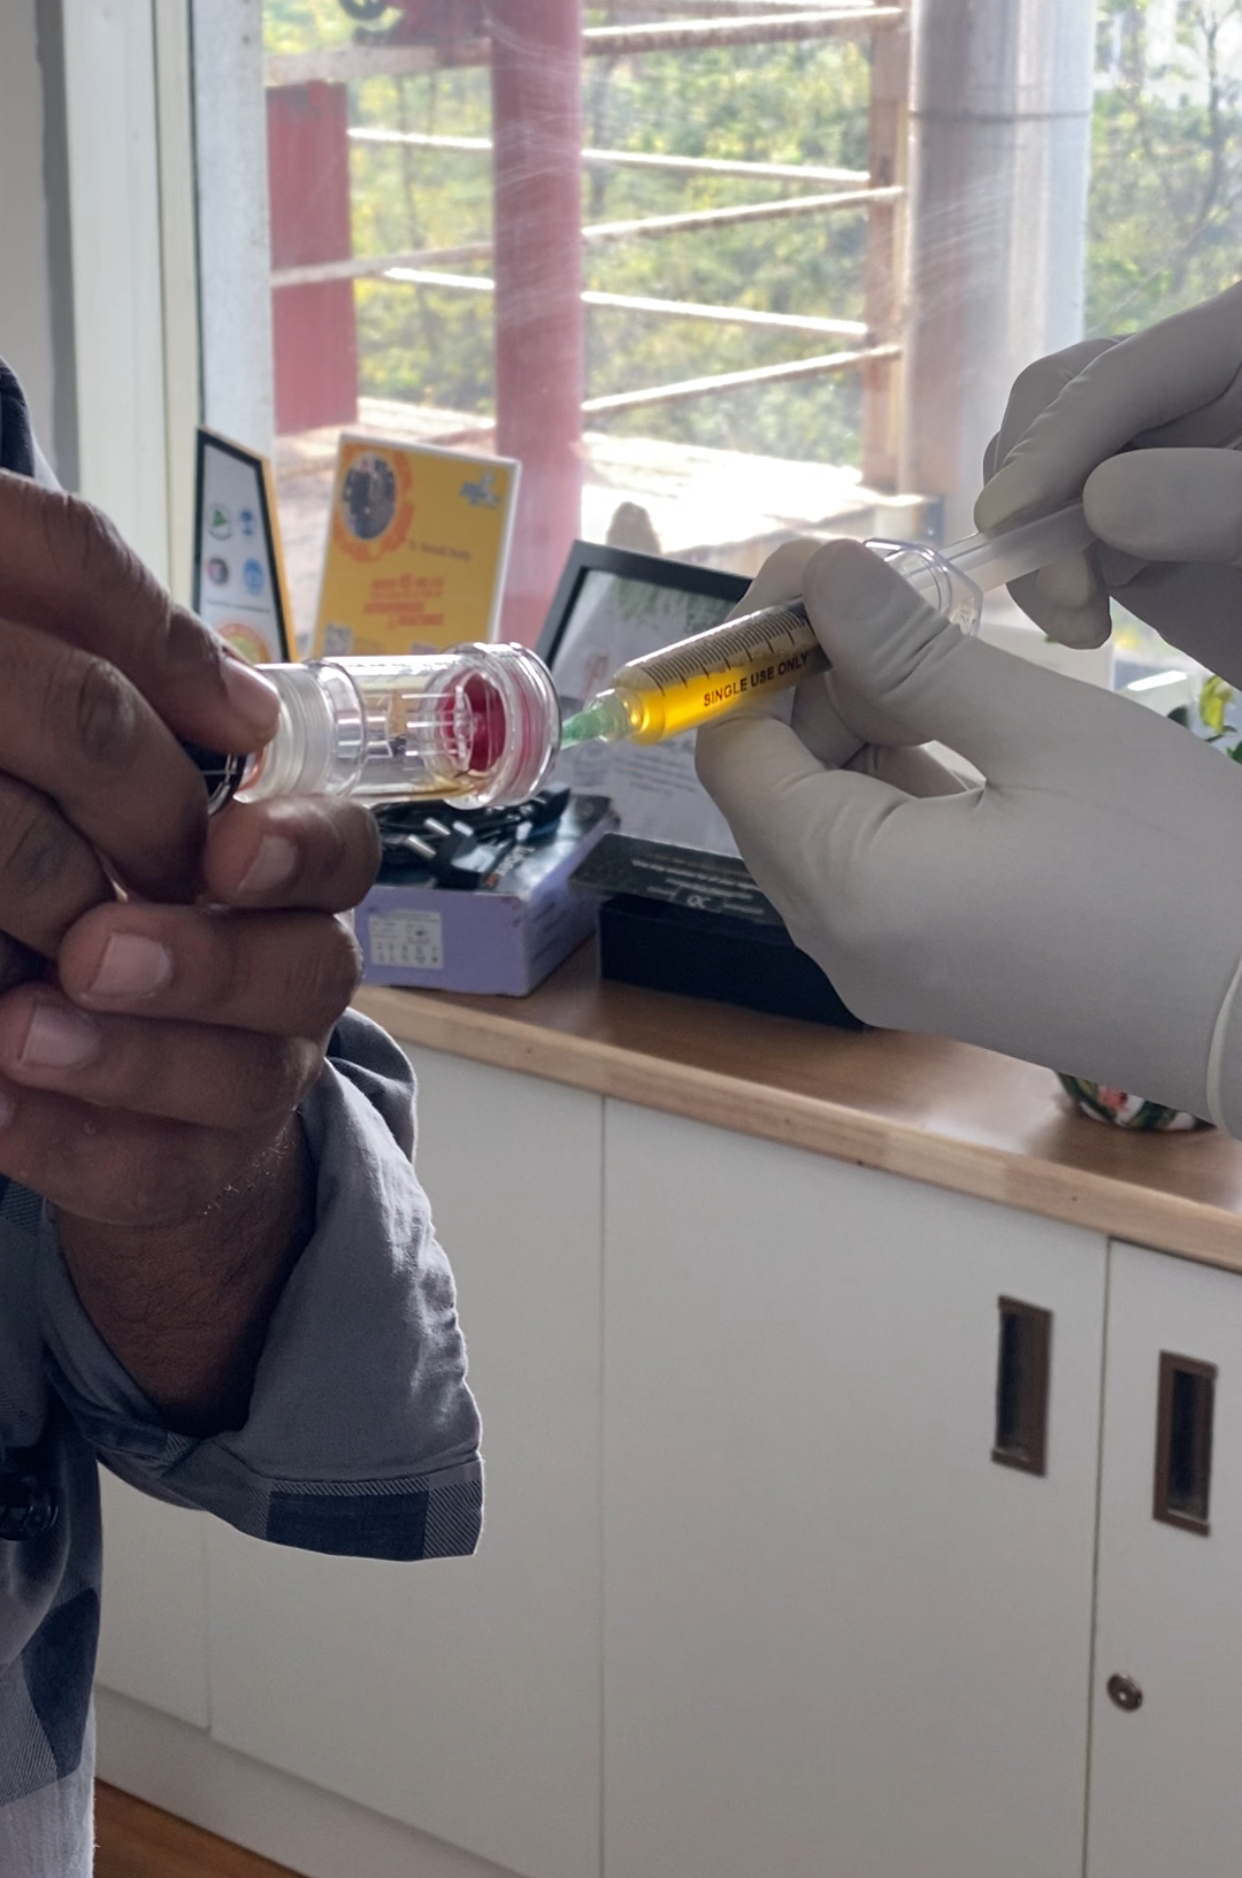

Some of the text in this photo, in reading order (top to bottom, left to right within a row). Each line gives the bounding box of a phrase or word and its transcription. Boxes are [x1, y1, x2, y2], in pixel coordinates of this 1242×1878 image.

[703, 652, 808, 707] SINGLE USE ONLY
